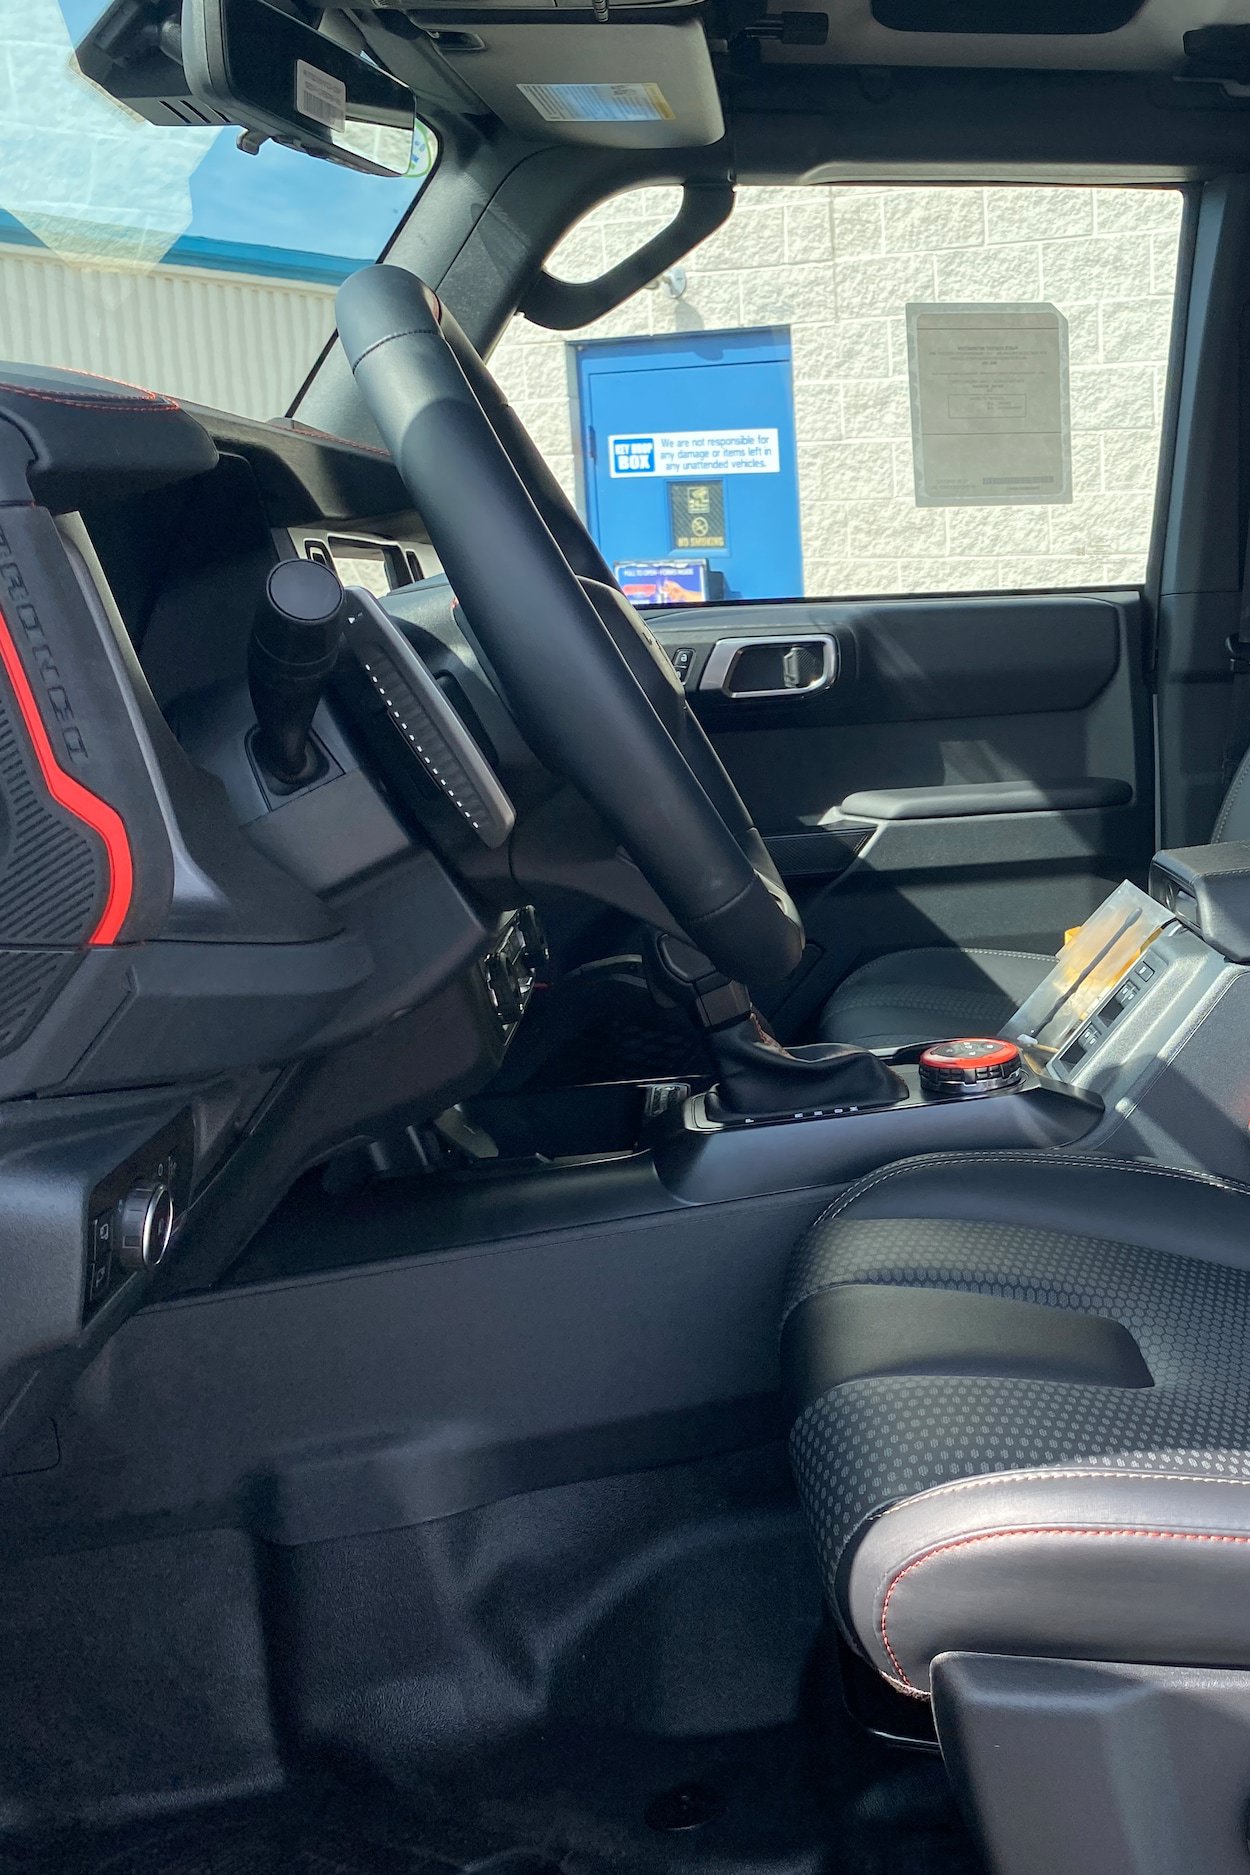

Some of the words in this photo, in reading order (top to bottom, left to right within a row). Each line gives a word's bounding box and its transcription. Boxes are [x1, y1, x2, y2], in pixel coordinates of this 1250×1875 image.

[661, 438, 674, 448] We
[692, 438, 705, 447] not
[707, 435, 755, 450] responsible
[758, 435, 769, 444] for
[660, 452, 674, 460] any
[678, 450, 710, 461] damage
[712, 449, 720, 457] or
[723, 448, 746, 457] items
[748, 447, 764, 456] left
[765, 447, 772, 455] in
[618, 455, 650, 470] BOX
[665, 463, 679, 472] any
[683, 460, 729, 470] unattended
[732, 459, 767, 468] vehicles.
[678, 537, 689, 547] NO
[691, 536, 724, 546] SMOKING
